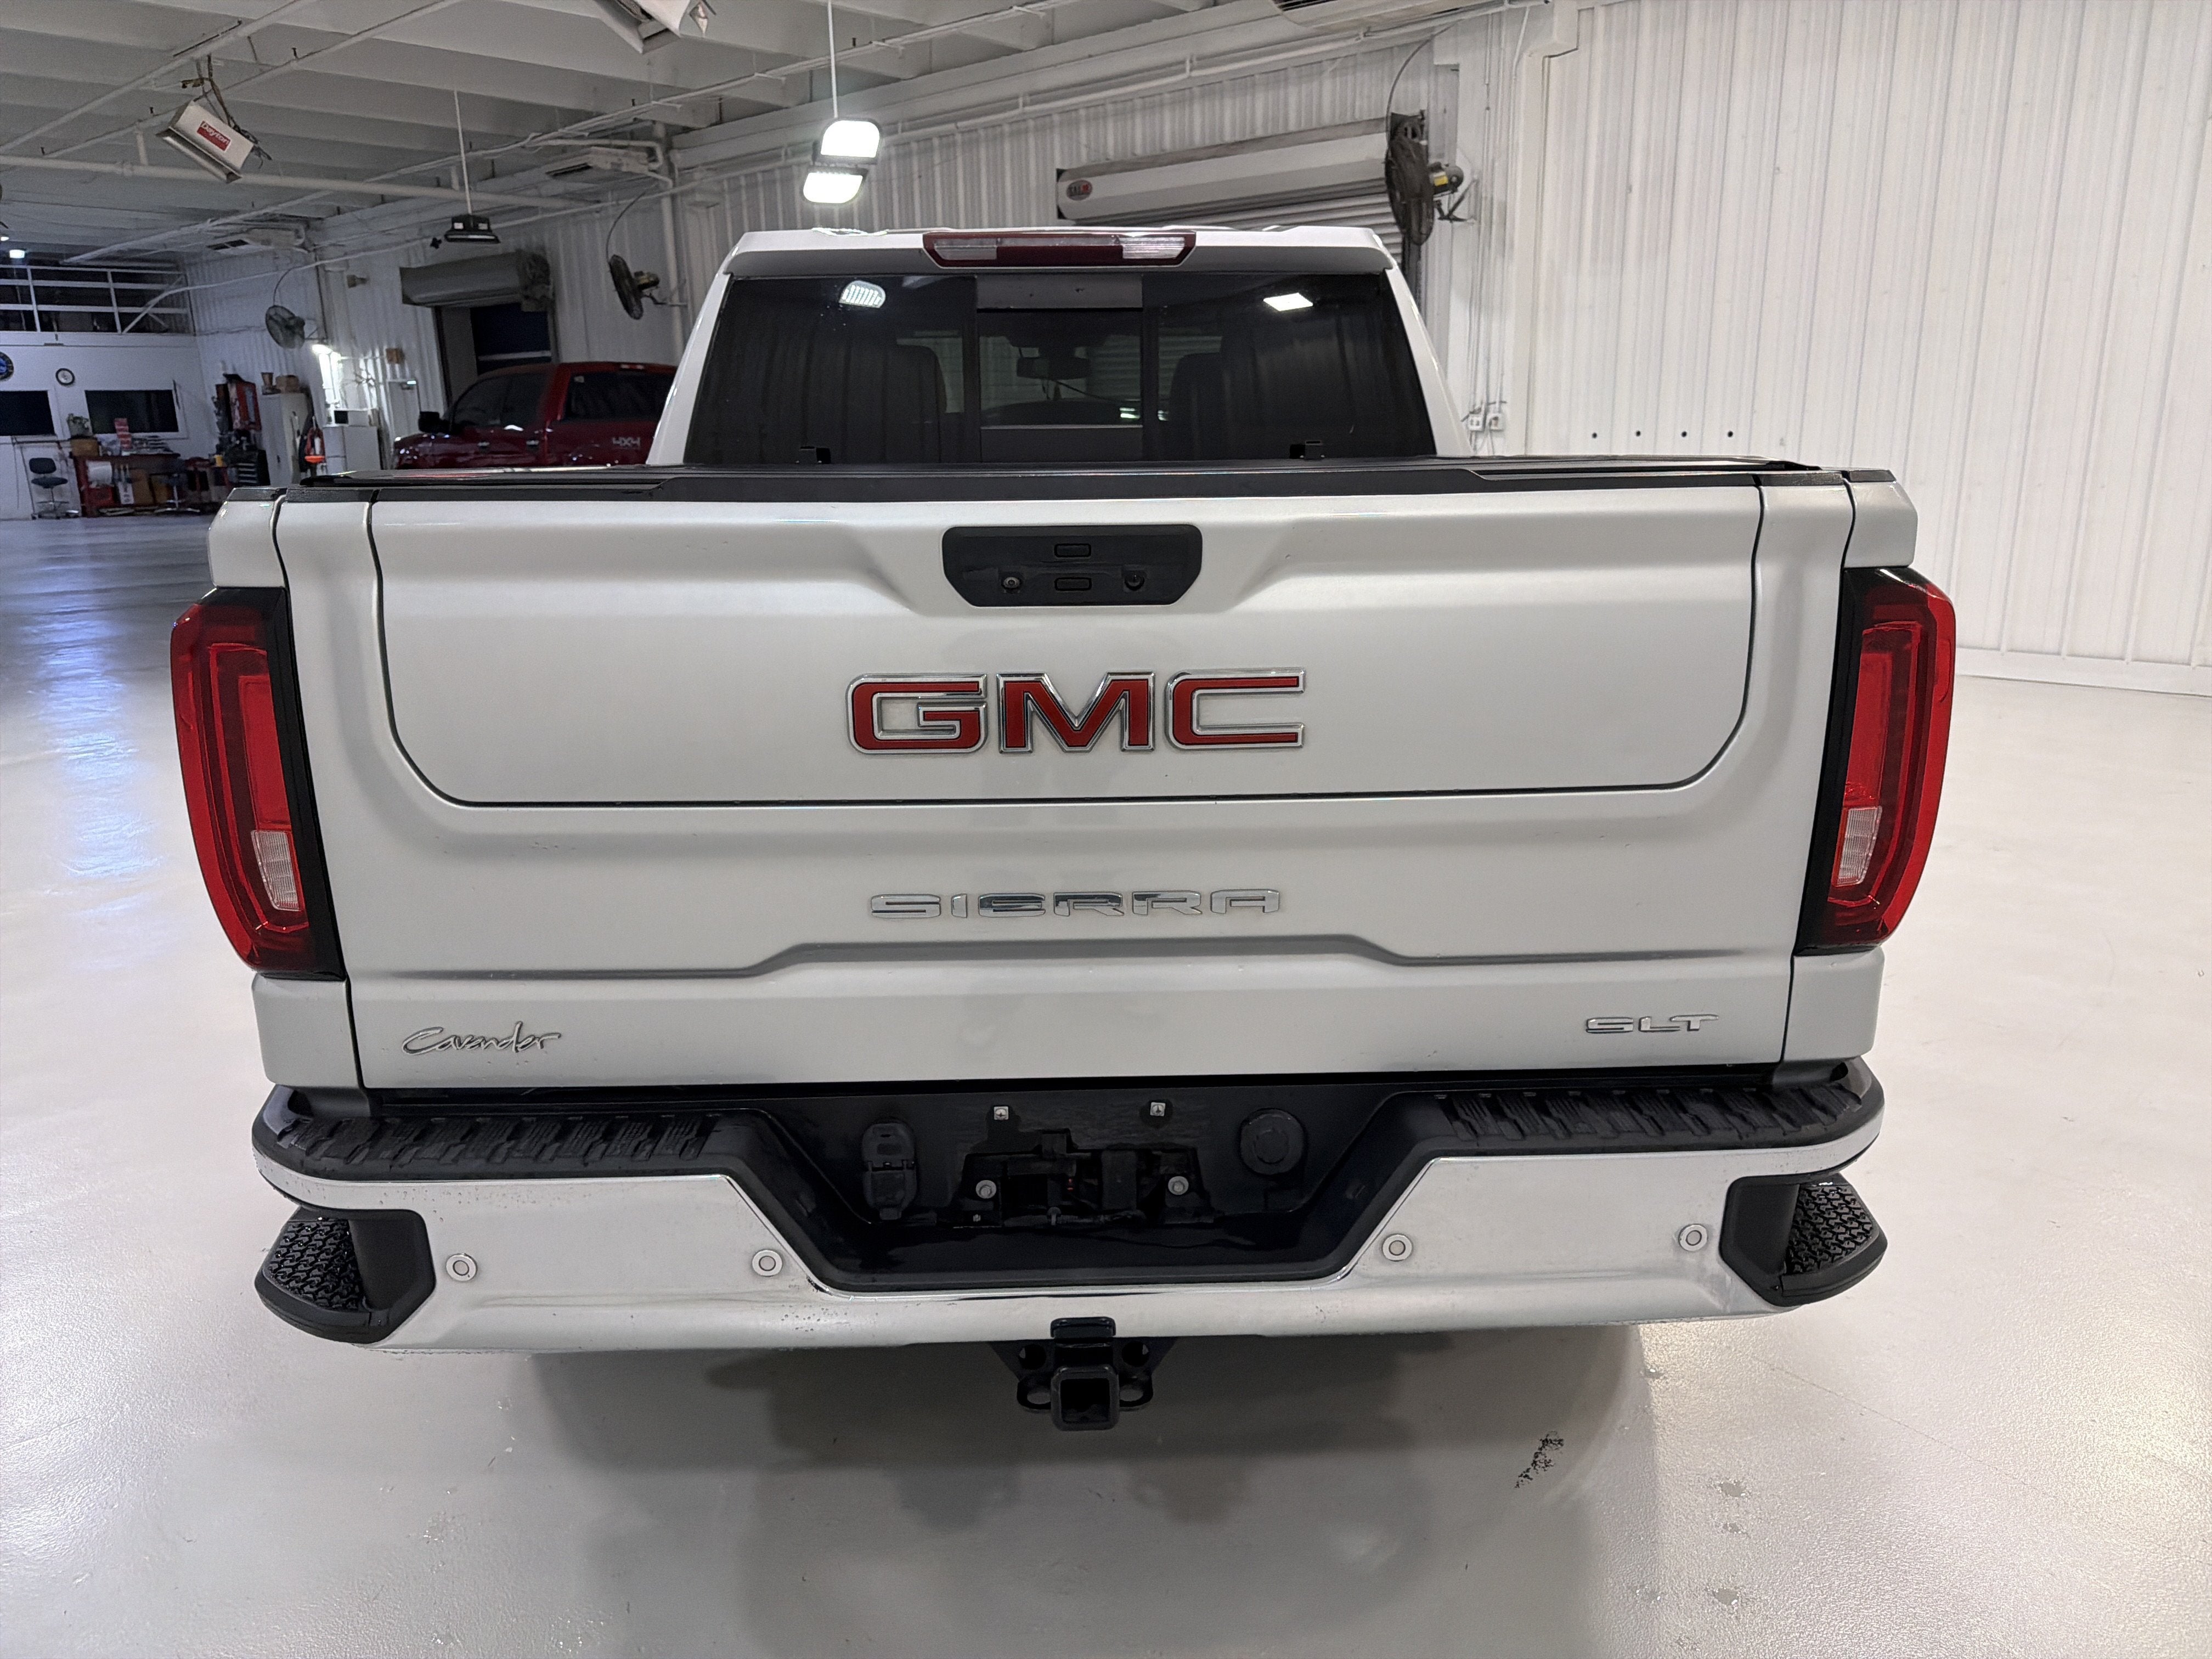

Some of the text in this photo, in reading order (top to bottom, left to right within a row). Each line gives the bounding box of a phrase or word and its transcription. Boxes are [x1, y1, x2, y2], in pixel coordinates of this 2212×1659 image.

[200, 122, 229, 145] Dayton
[846, 667, 1306, 755] GMC
[871, 889, 1280, 918] SIERRA
[402, 1020, 562, 1055] Cavender
[1586, 1014, 1719, 1034] SLT
